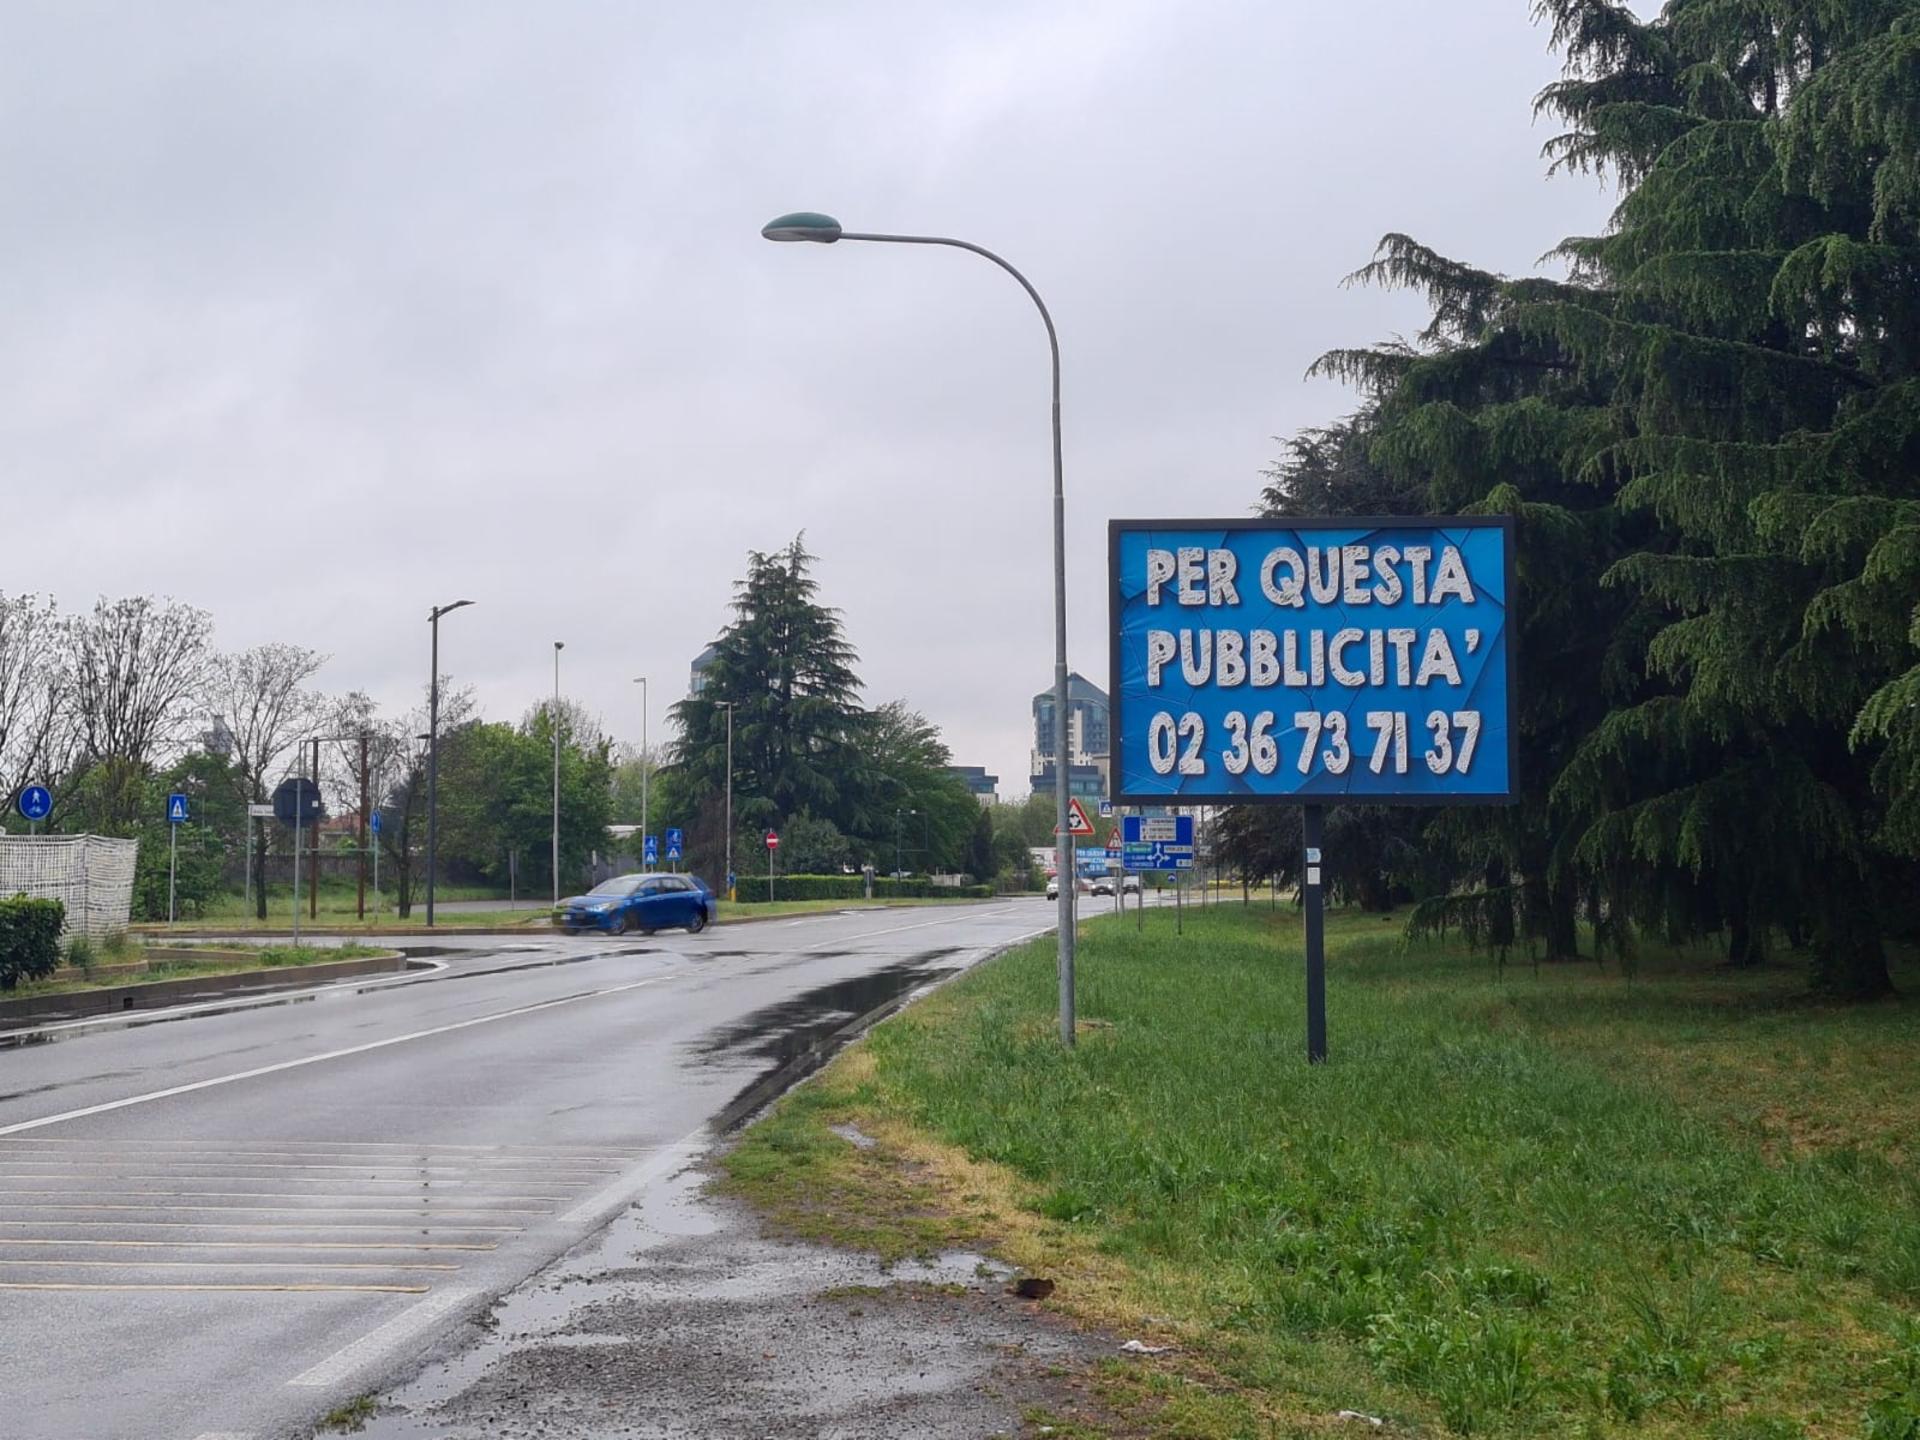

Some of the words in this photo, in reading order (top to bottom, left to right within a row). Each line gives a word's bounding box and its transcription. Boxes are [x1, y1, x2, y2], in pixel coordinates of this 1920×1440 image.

[1147, 548, 1240, 606] PER
[1260, 545, 1475, 608] QUESTA
[1149, 713, 1205, 775] 02
[1224, 711, 1278, 775] 36
[1294, 711, 1350, 775] 73
[1366, 711, 1408, 774] 71
[1426, 710, 1481, 775] 37
